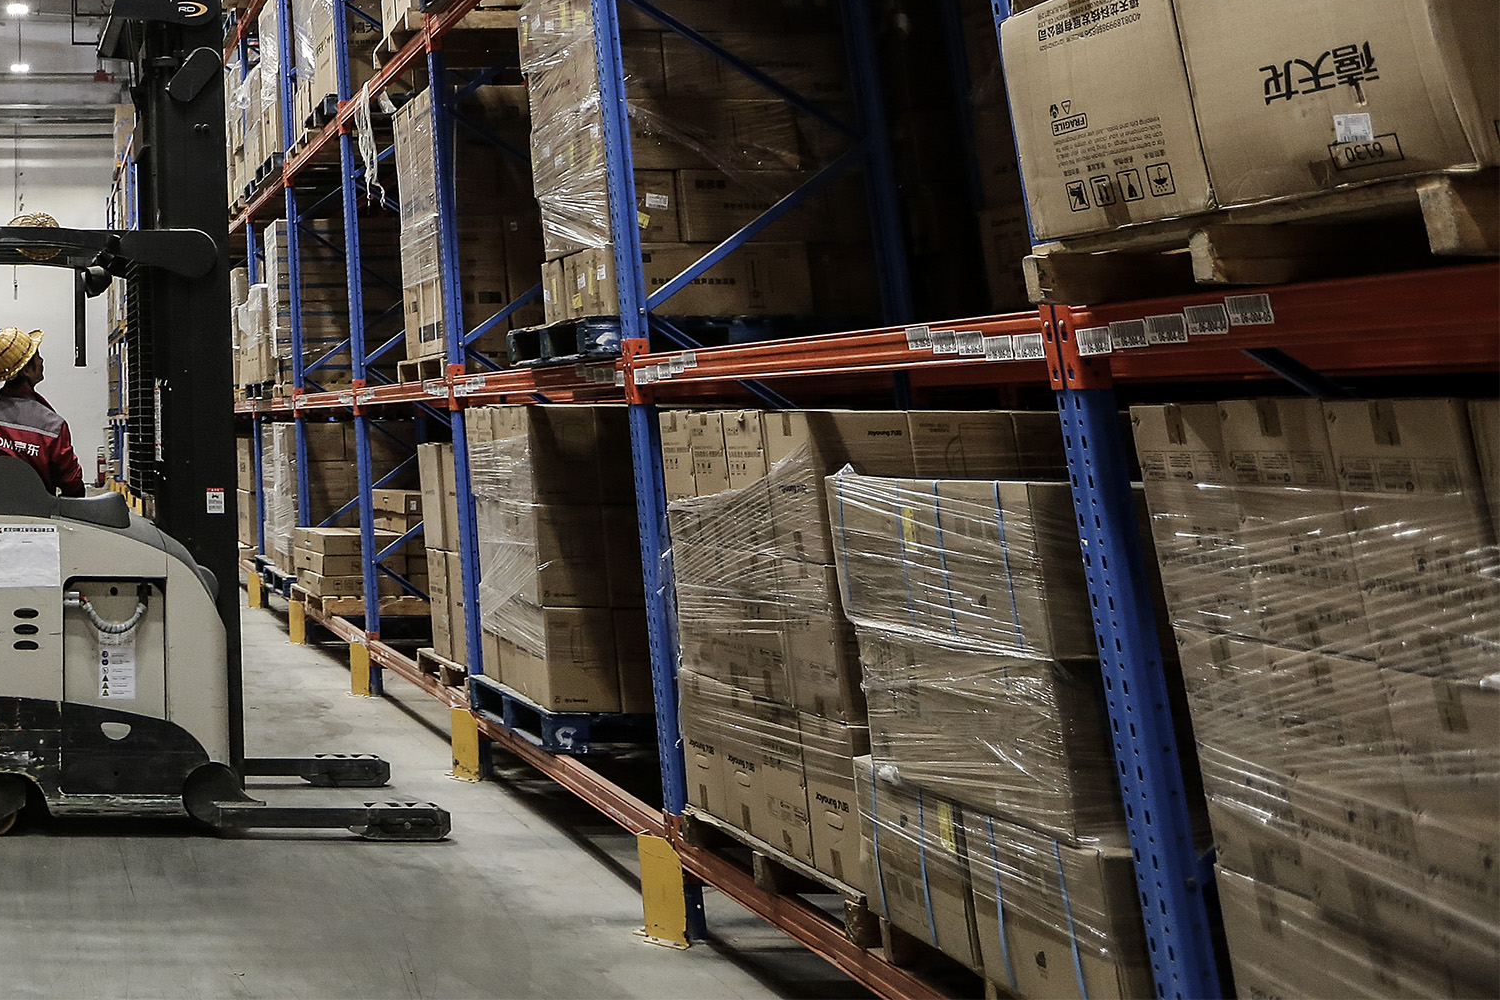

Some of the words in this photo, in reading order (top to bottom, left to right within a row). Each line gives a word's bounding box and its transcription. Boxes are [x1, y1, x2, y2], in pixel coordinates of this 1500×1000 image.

[1259, 41, 1380, 105] 禧天龙
[1054, 116, 1085, 132] FRAGILE
[1344, 141, 1384, 163] 6130
